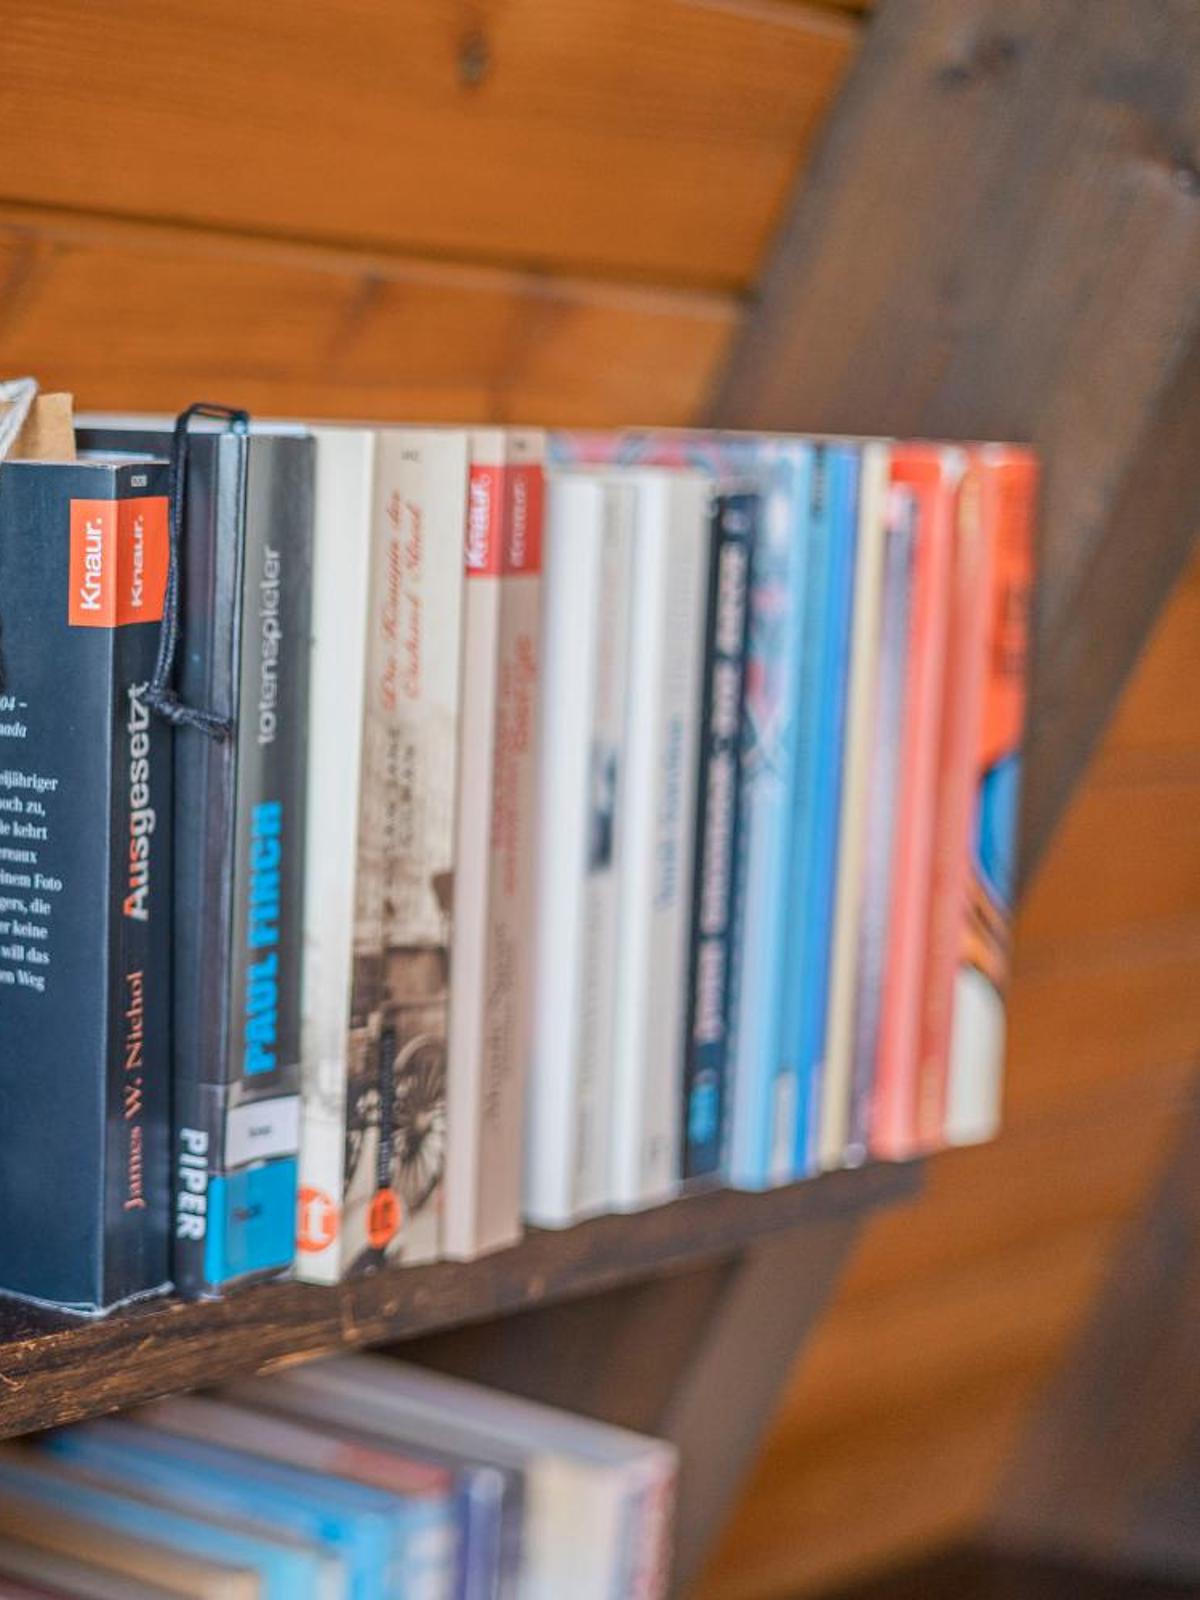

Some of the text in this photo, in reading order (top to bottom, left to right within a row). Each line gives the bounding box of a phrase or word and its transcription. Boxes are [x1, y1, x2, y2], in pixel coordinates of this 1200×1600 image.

[80, 517, 102, 610] Knaur.
[131, 514, 143, 608] Knaur.
[257, 545, 282, 745] totenspieler
[13, 821, 48, 840] kehrt
[25, 800, 46, 817] zu,
[122, 681, 156, 923] Ausgesetzt
[29, 898, 51, 916] die
[33, 873, 63, 892] Foto
[0, 944, 25, 962] will
[26, 947, 50, 965] das
[12, 920, 49, 939] keine
[243, 800, 282, 1076] PAUL FINCH
[16, 969, 45, 992] Weg
[123, 970, 146, 1213] James W. Nichol
[176, 1127, 210, 1241] PIPER
